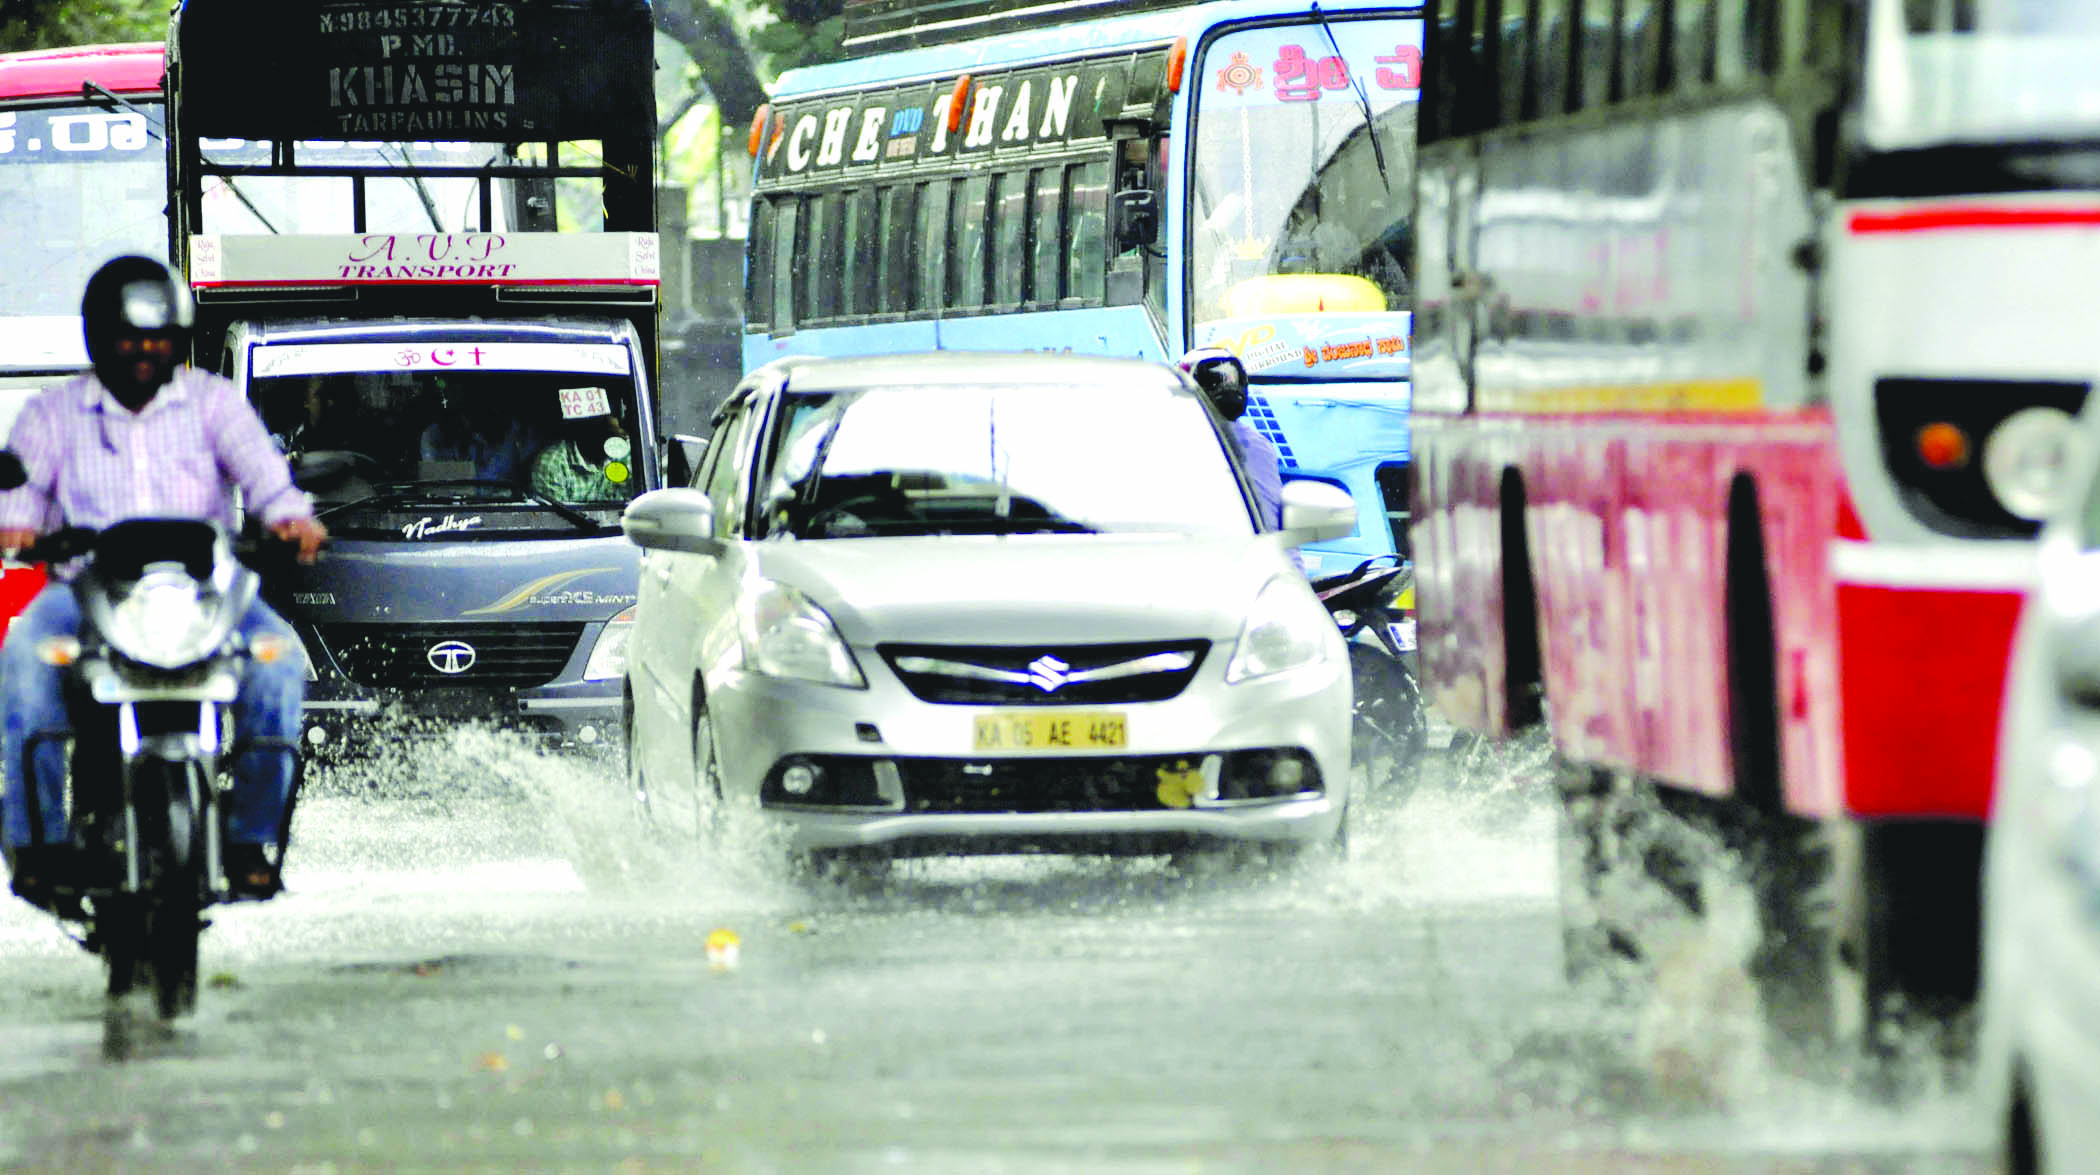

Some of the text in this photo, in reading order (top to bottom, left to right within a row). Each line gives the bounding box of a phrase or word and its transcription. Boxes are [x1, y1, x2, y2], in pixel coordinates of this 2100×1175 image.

[329, 64, 515, 107] KHASIM
[337, 110, 508, 133] TARPAULINS
[890, 106, 923, 137] DVD
[931, 75, 1078, 152] THAN
[788, 107, 886, 172] CHE
[338, 264, 517, 278] TRANSPORT
[1246, 341, 1286, 361] DIGITAL
[1248, 349, 1304, 372] URROUND
[560, 391, 582, 403] KA
[564, 404, 583, 417] TC
[977, 720, 1001, 746] KA
[1049, 719, 1072, 746] AE
[1089, 718, 1126, 746] 4421
